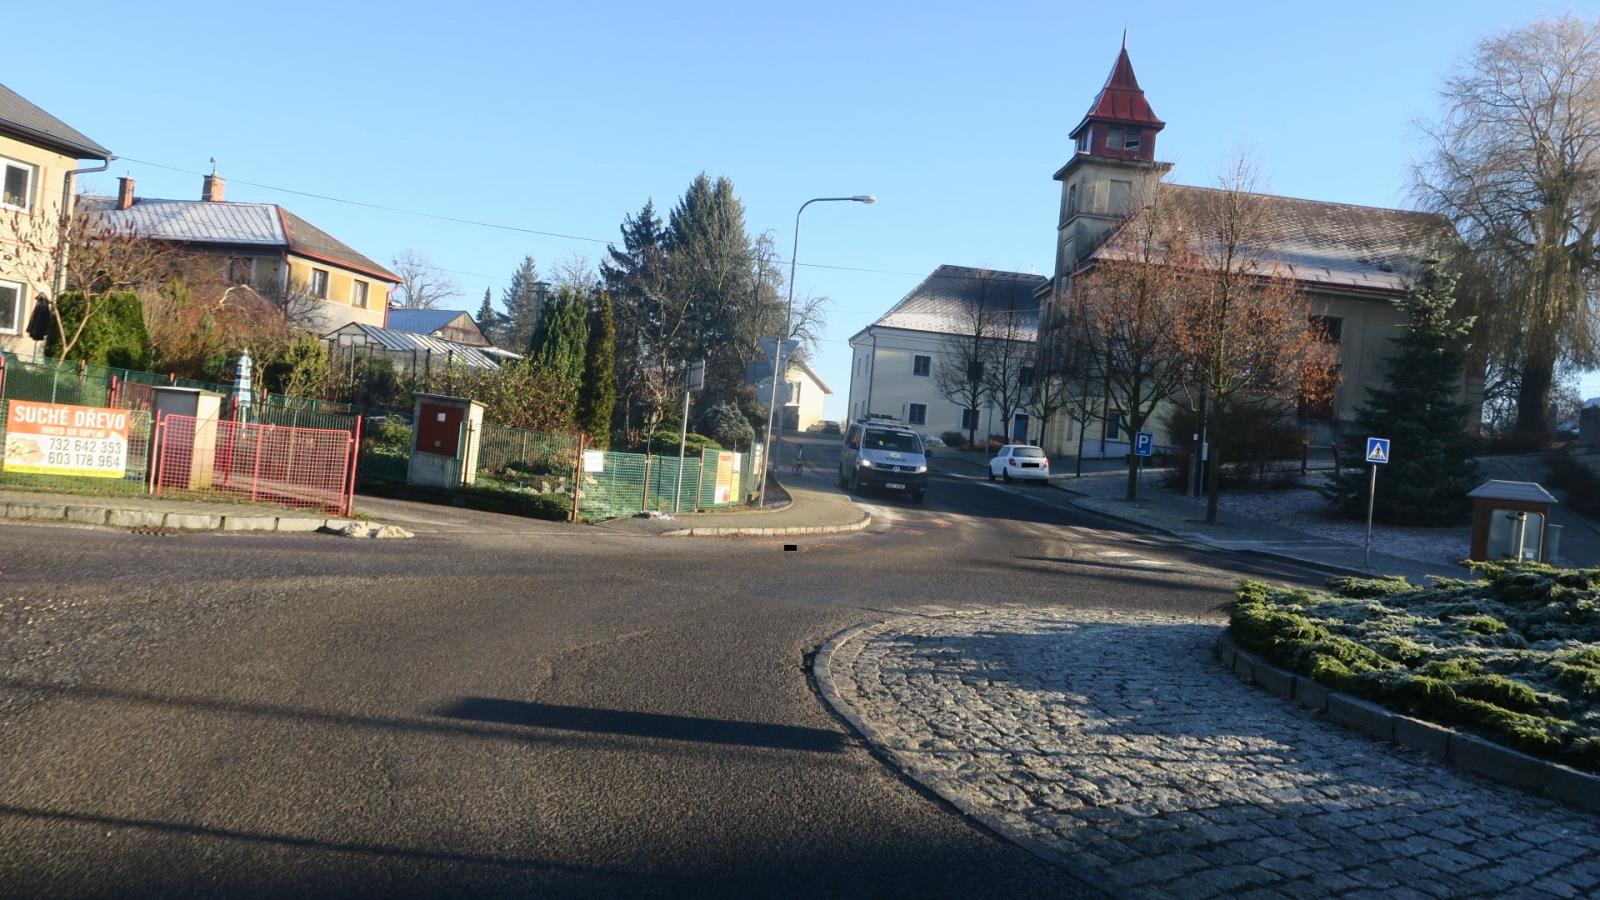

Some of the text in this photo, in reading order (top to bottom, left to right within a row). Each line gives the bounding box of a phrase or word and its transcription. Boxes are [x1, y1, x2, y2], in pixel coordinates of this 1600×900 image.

[15, 406, 125, 429] SUCHÉ DŘEVO
[49, 438, 122, 455] 732 642 353
[1138, 435, 1149, 449] P
[48, 452, 120, 468] 603 178 964
